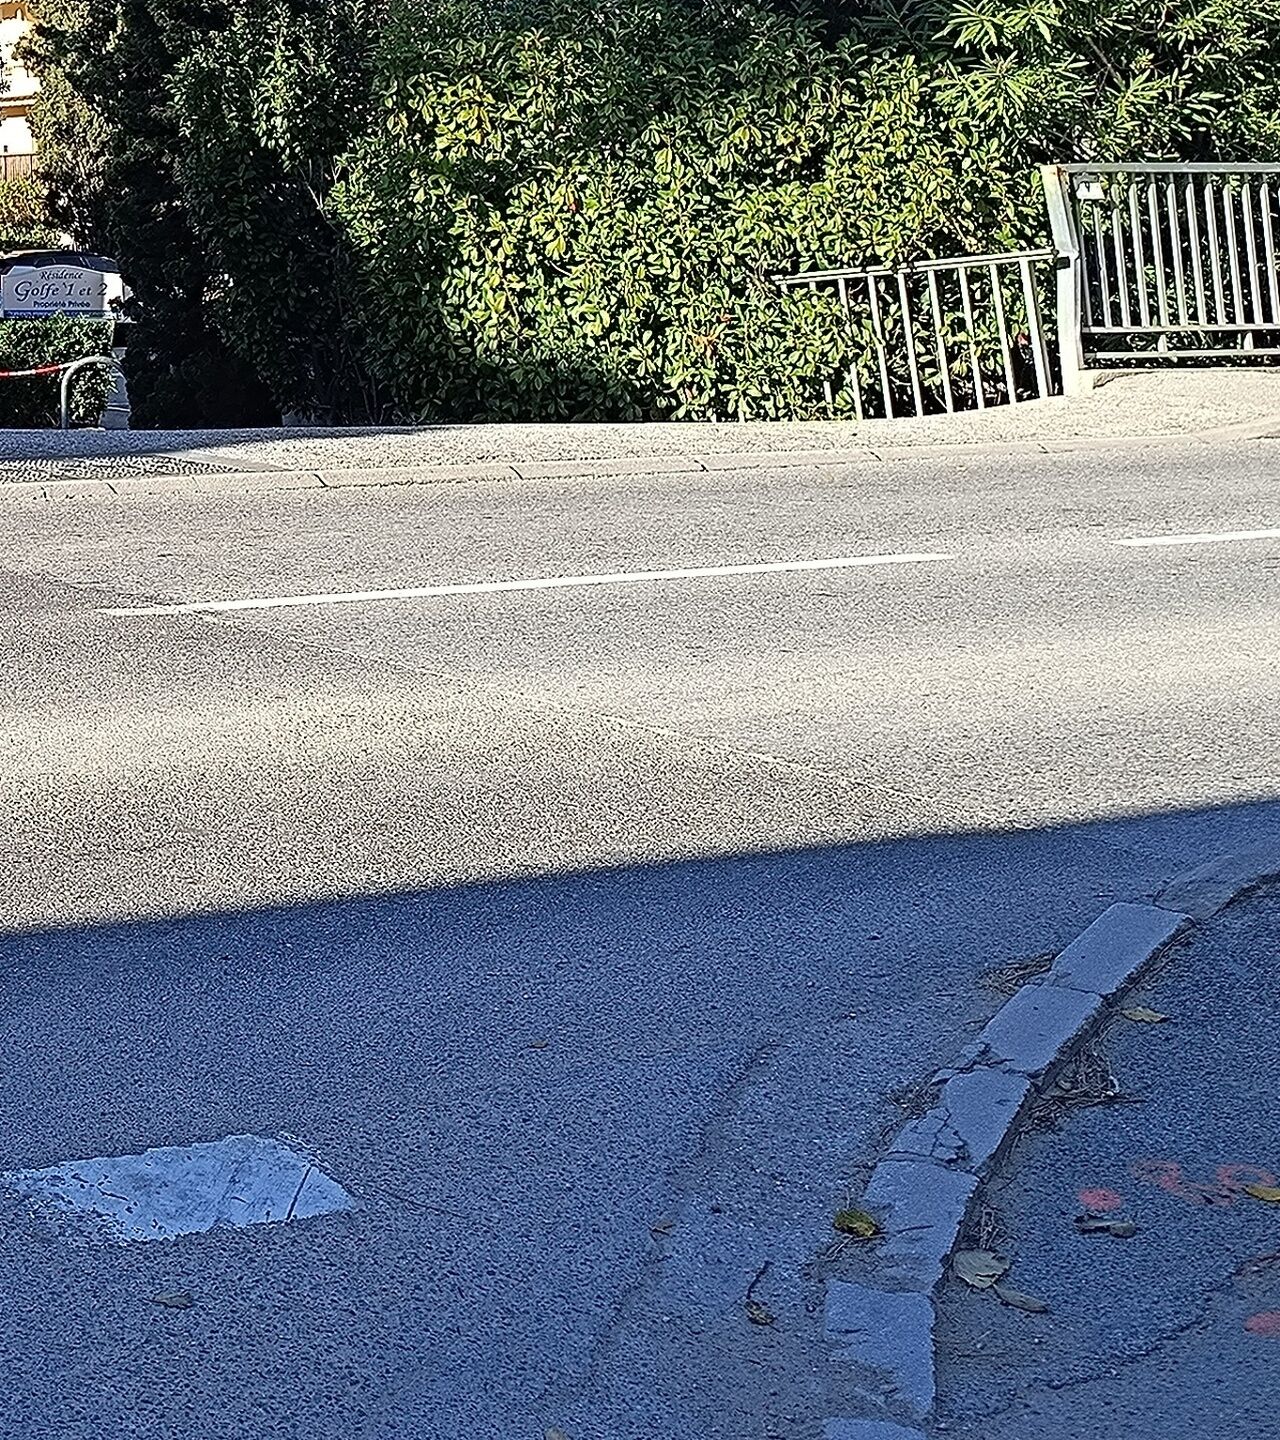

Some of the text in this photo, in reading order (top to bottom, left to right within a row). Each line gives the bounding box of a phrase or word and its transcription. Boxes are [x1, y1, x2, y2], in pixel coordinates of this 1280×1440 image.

[40, 269, 84, 281] Résidence
[14, 280, 60, 302] Golfe
[78, 286, 92, 296] et
[96, 282, 108, 296] 2
